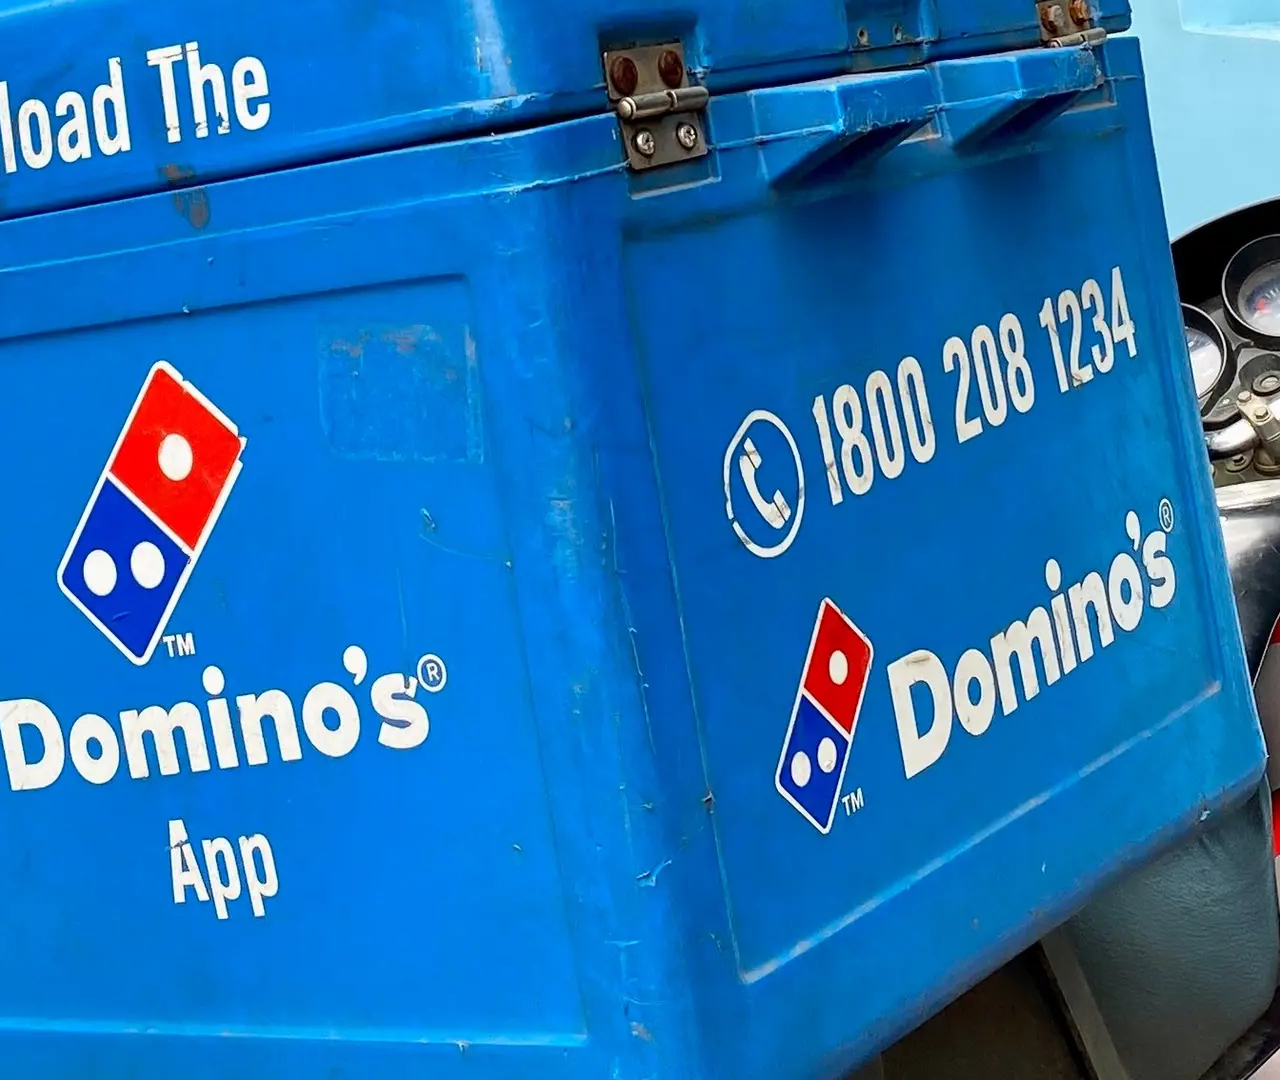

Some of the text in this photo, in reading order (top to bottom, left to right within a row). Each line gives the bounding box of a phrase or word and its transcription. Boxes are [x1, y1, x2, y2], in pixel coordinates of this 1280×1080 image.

[146, 42, 271, 144] The
[812, 266, 1137, 506] 1800 208 1234
[163, 633, 195, 657] TM
[170, 819, 280, 919] App
